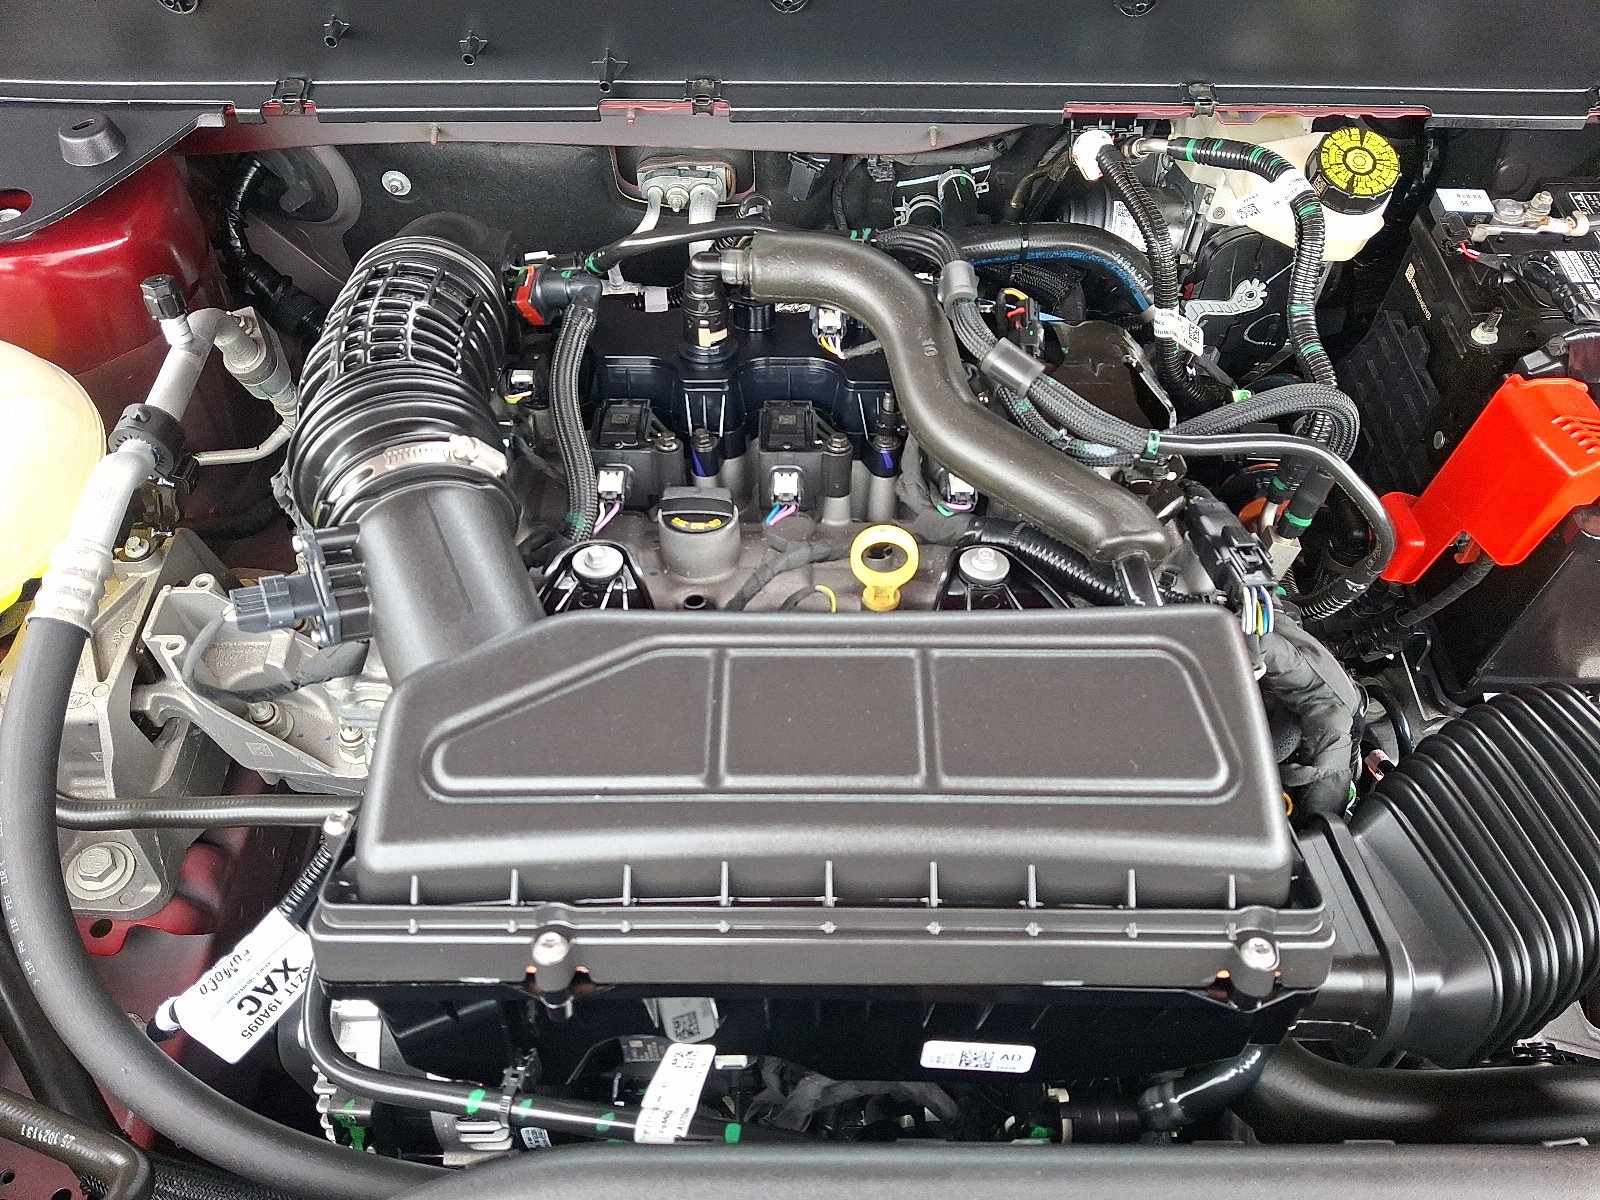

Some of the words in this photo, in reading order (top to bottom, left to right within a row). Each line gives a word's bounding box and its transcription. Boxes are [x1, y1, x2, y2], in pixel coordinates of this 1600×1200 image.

[236, 957, 301, 1017] XAC
[240, 998, 283, 1040] 19A095
[1000, 1054, 1022, 1062] AD
